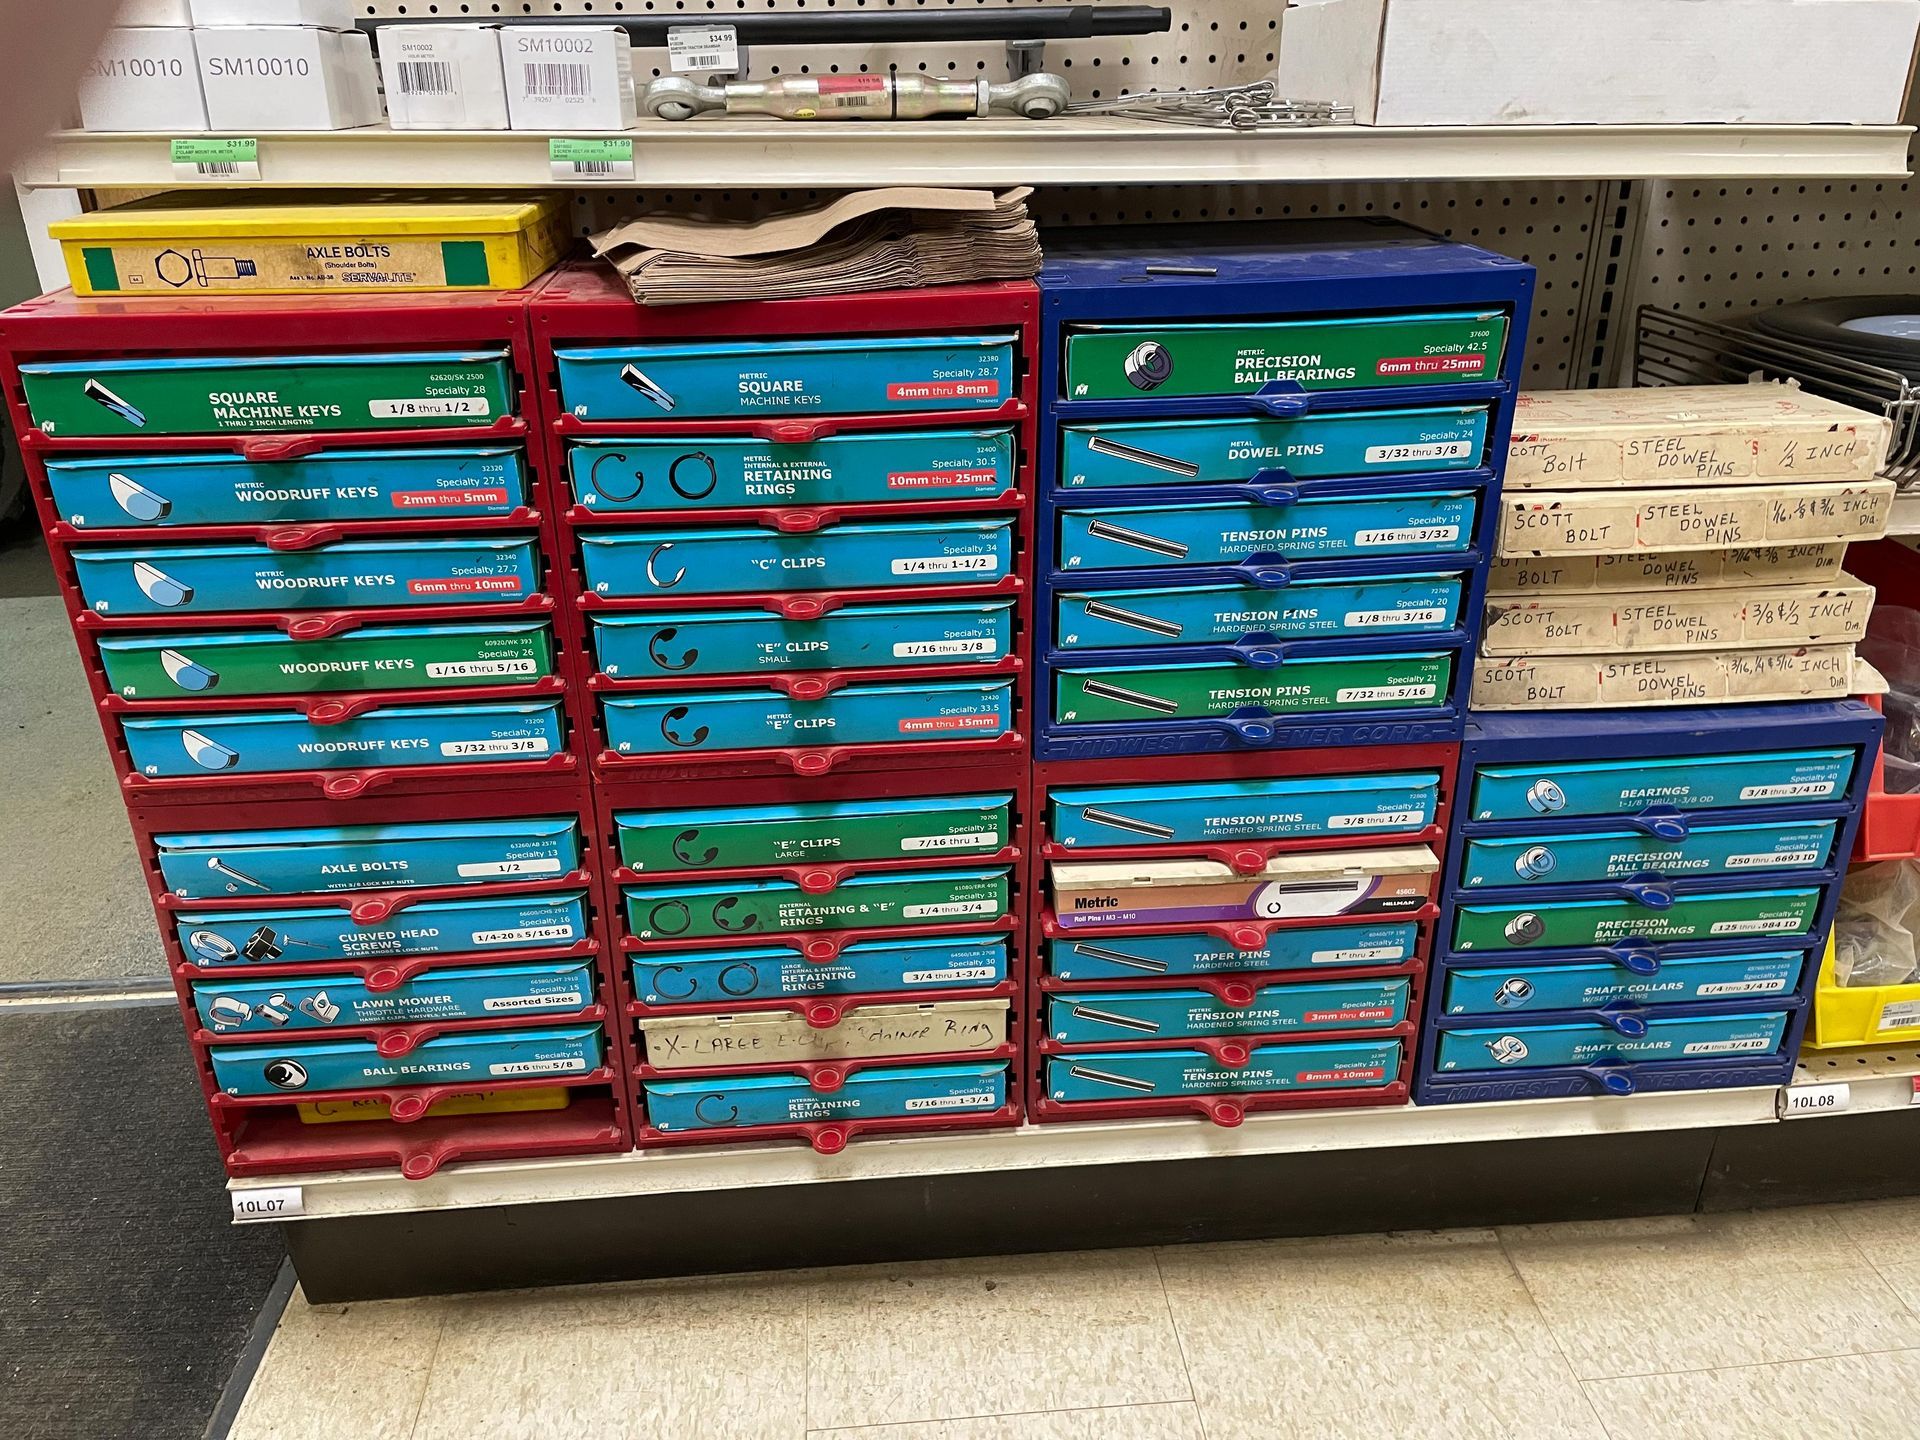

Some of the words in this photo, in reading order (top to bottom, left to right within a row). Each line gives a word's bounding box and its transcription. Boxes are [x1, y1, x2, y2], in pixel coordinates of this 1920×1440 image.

[518, 38, 593, 53] SM10002
[209, 58, 309, 76] SM10010
[226, 140, 255, 148] $31.99
[603, 140, 631, 148] $31.99
[307, 247, 341, 258] AXLE
[345, 246, 390, 258] BOLTS
[1424, 344, 1464, 354] Specialty
[1467, 342, 1488, 351] 42.5
[1235, 356, 1321, 369] PRECISION
[1379, 362, 1411, 372] 6mm
[1415, 361, 1438, 370] thru
[1441, 359, 1482, 369] 25mm
[933, 369, 974, 379] Specialty
[978, 368, 998, 376] 28.7
[425, 386, 469, 396] Specialty
[473, 386, 486, 394] 28
[738, 381, 803, 394] SQUARE
[897, 386, 929, 396] 4mm
[932, 386, 953, 395] thru
[956, 384, 988, 394] 8mm
[209, 392, 278, 405] SQUARE
[740, 396, 791, 406] MACHINE
[794, 396, 821, 404] KEYS
[213, 406, 293, 419] MACHINE
[298, 405, 342, 418] KEYS
[390, 403, 416, 414] 1/8
[419, 404, 441, 413] thru
[445, 402, 470, 412] 1/2
[1228, 447, 1282, 460] DOWEL
[1287, 444, 1324, 456] PINS
[1378, 448, 1410, 458] 3/32
[1412, 448, 1432, 456] thru
[1435, 445, 1458, 456] 3/8
[1628, 438, 1686, 455] STEEL
[1806, 442, 1856, 460] INCH
[1658, 450, 1718, 467] DOWEL
[744, 469, 832, 482] RETAINING
[1696, 463, 1734, 478] PINS
[235, 489, 331, 502] WOODRUFF
[337, 487, 379, 499] KEYS
[746, 484, 796, 495] RINGS
[404, 495, 436, 505] 2mm
[439, 494, 461, 503] thru
[464, 492, 498, 502] 5mm
[1843, 498, 1878, 511] INCH
[1644, 504, 1703, 521] STEEL
[1514, 513, 1573, 529] SCOTT
[1680, 513, 1739, 531] DOWEL
[1221, 529, 1287, 542] TENSION
[1291, 527, 1328, 538] PINS
[1566, 526, 1611, 543] BOLT
[1705, 528, 1742, 544] PINS
[751, 559, 776, 570] "C"
[782, 558, 826, 569] CLIPS
[903, 561, 925, 571] 1/4
[928, 561, 948, 569] thru
[951, 559, 986, 568] 1-1/2
[256, 577, 349, 590] WOODRUFF
[354, 575, 395, 586] KEYS
[1214, 611, 1280, 622] TENSION
[1283, 609, 1318, 620] PINS
[1500, 611, 1555, 626] SCOTT
[1622, 605, 1676, 621] STEEL
[1809, 601, 1853, 618] INCH
[1653, 614, 1708, 630] DOWEL
[1546, 624, 1582, 637] BOLT
[1686, 630, 1718, 643] PINS
[757, 643, 781, 653] "E"
[786, 641, 829, 652] CLIPS
[280, 661, 370, 674] WOODRUFF
[375, 659, 415, 671] KEYS
[759, 656, 791, 664] SMALL
[1800, 657, 1840, 672] INCH
[1483, 668, 1536, 683] SCOTT
[1606, 662, 1666, 678] STEEL
[1638, 674, 1695, 691] DOWEL
[1209, 688, 1273, 700] TENSION
[1276, 686, 1311, 696] PINS
[1528, 686, 1566, 700] BOLT
[1671, 685, 1705, 699] PINS
[766, 720, 790, 731] "E"
[794, 718, 836, 729] CLIPS
[298, 740, 385, 753] WOODRUFF
[390, 739, 430, 750] KEYS
[1620, 787, 1690, 798] BEARINGS
[1204, 816, 1266, 827] TENSION
[1270, 814, 1303, 823] PINS
[1343, 816, 1365, 826] 3/8
[1367, 816, 1385, 824] thru
[1387, 814, 1409, 823] 1/2
[1203, 827, 1254, 835] HARDENED
[1257, 825, 1292, 833] SPRING
[1294, 823, 1322, 831] STEEL
[773, 840, 796, 849] "E"
[801, 838, 841, 848] CLIPS
[506, 851, 544, 860] Specialty
[775, 850, 805, 858] LARGE
[1609, 852, 1683, 863] PRECISION
[321, 864, 357, 874] AXLE
[362, 861, 408, 872] BOLTS
[499, 863, 520, 872] 1/2
[1607, 862, 1640, 872] BALL
[1642, 859, 1710, 871] BEARINGS
[1074, 896, 1118, 909] Metric
[779, 906, 856, 917] RETAINING
[1758, 911, 1792, 919] Specialty
[780, 917, 824, 926] RINGS
[1597, 919, 1669, 929] PRECISION
[339, 932, 396, 943] CURVED
[401, 928, 439, 939] HEAD
[1595, 929, 1626, 938] BALL
[1629, 926, 1696, 936] BEARINGS
[342, 941, 401, 951] SCREWS
[1194, 952, 1235, 962] TAPER
[1240, 951, 1271, 959] PINS
[782, 971, 856, 983] RETAINING
[783, 983, 825, 992] RINGS
[1584, 985, 1625, 995] SHAFT
[1628, 982, 1684, 992] COLLARS
[353, 999, 396, 1009] LAWN
[399, 995, 452, 1006] MOWER
[492, 997, 542, 1008] Assorted
[545, 995, 574, 1005] Sizes
[1187, 1011, 1244, 1021] TENSION
[1248, 1010, 1280, 1018] PINS
[1574, 1044, 1614, 1053] SHAFT
[1616, 1042, 1672, 1050] COLLARS
[363, 1066, 397, 1076] BALL
[401, 1062, 471, 1074] BEARINGS
[1183, 1071, 1238, 1081] TENSION
[1242, 1070, 1273, 1078] PINS
[788, 1099, 861, 1111] RETAINING
[1793, 1095, 1835, 1108] 10L08
[789, 1109, 831, 1118] RINGS
[238, 1200, 285, 1212] 10L07
